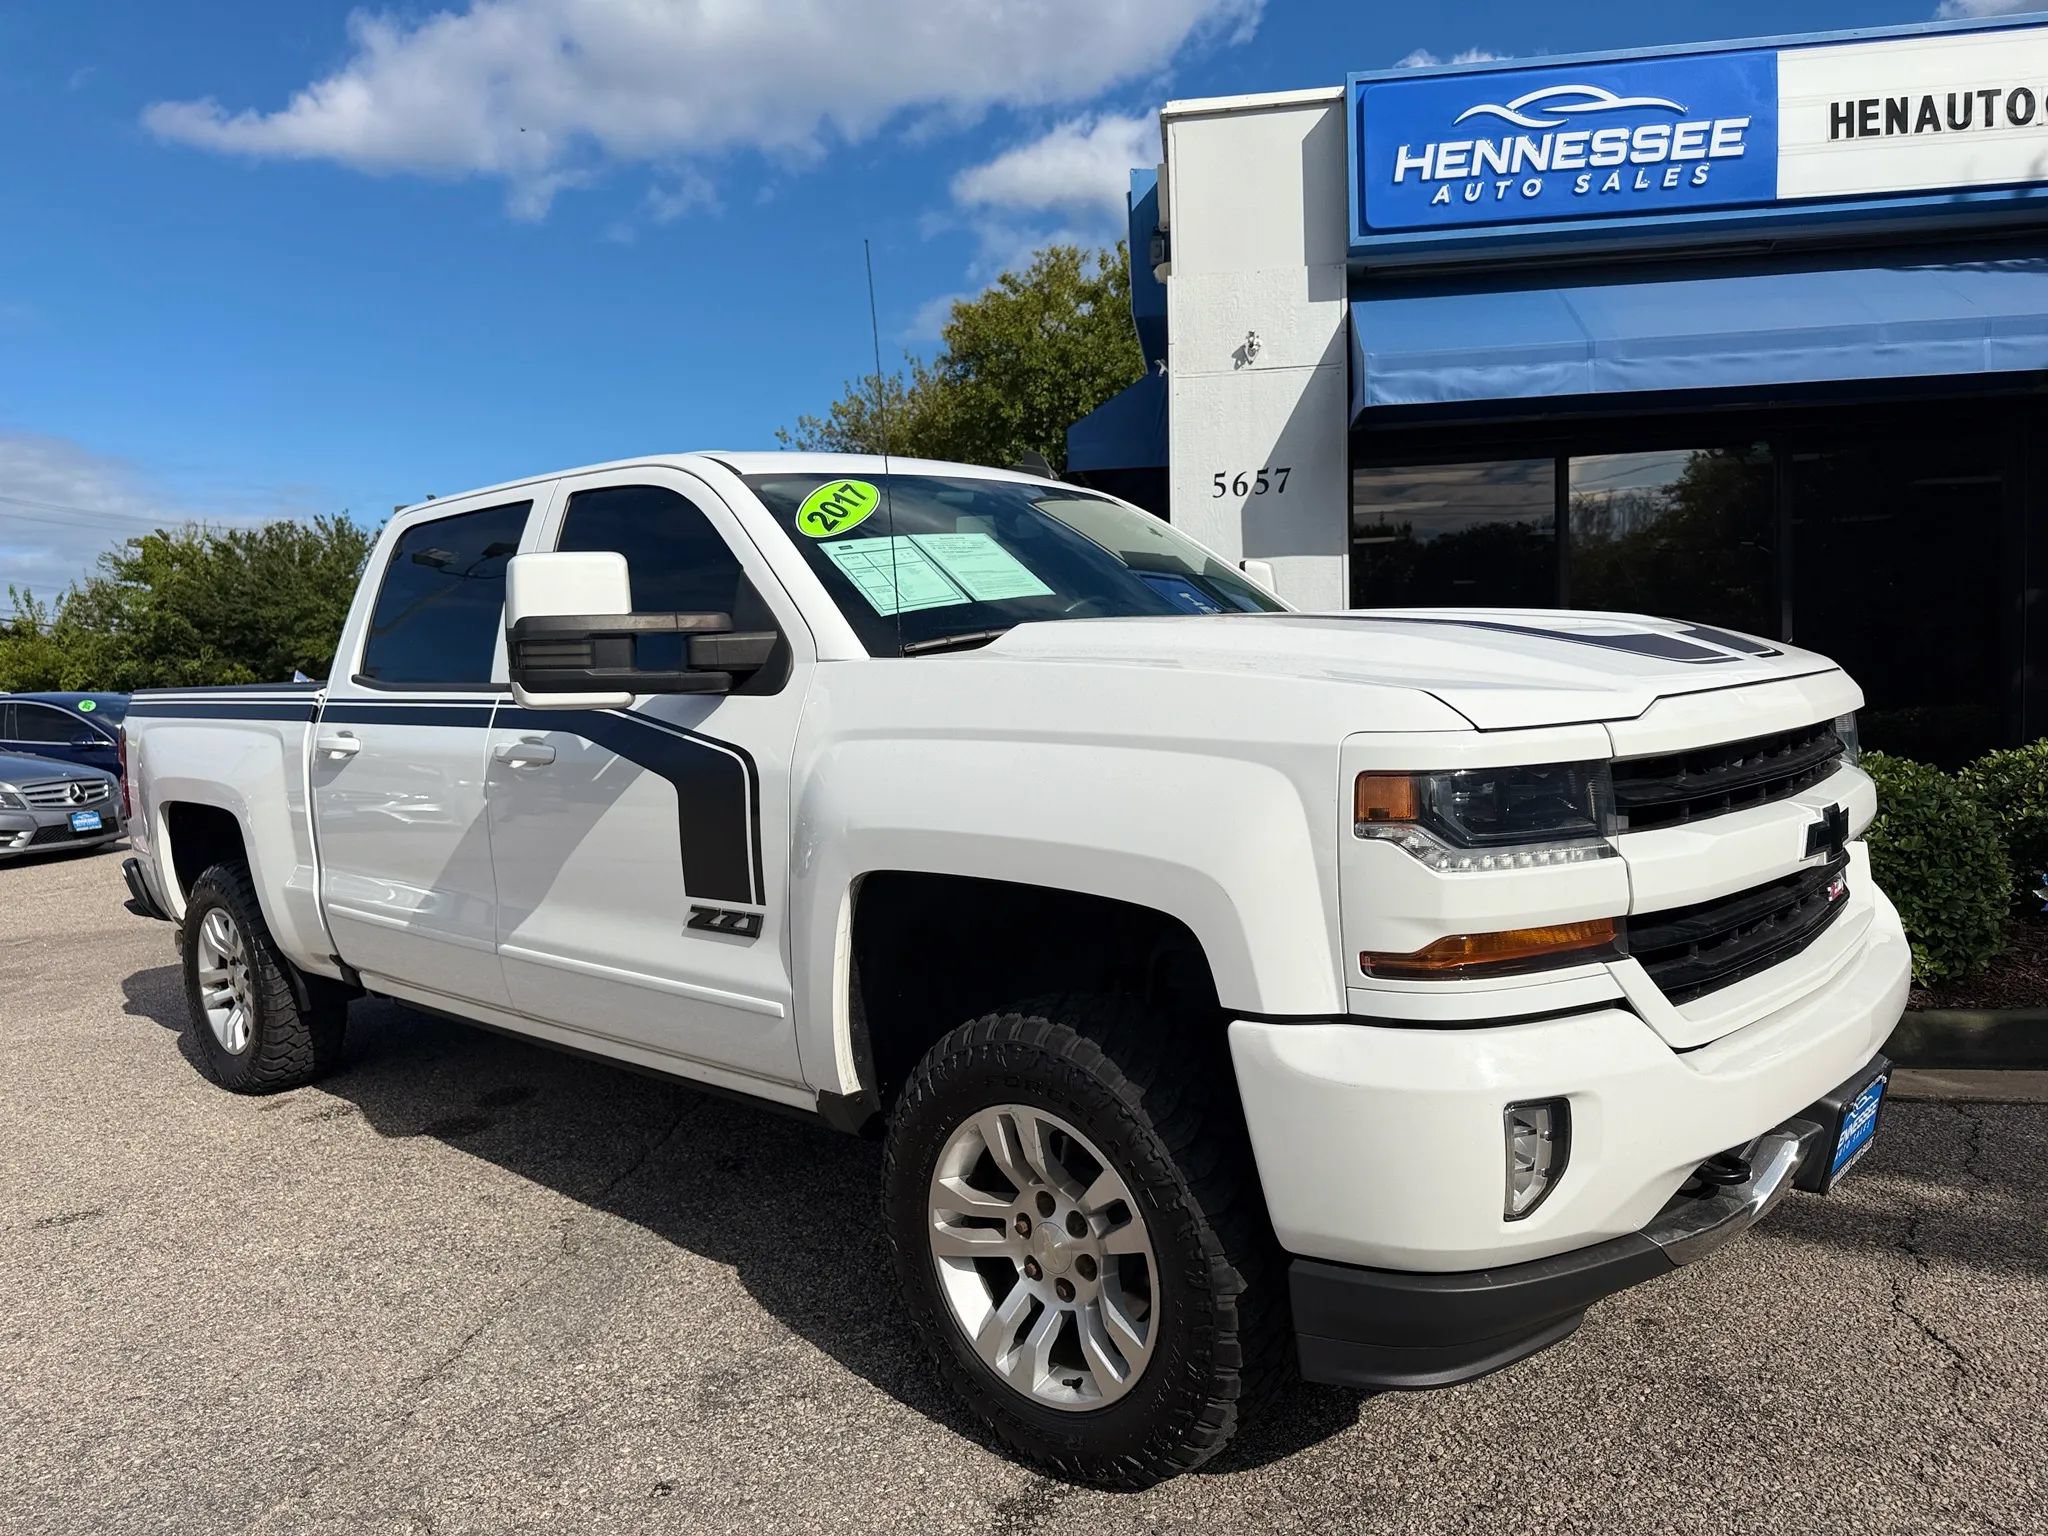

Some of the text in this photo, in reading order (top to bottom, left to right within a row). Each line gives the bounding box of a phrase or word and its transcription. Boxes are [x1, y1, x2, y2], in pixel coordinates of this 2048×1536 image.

[1831, 87, 2048, 139] HENAUTO
[1394, 117, 1750, 182] HENNESSEE
[1432, 163, 1710, 204] AUTO SALES
[1212, 467, 1291, 498] 5657
[807, 483, 868, 532] 2017
